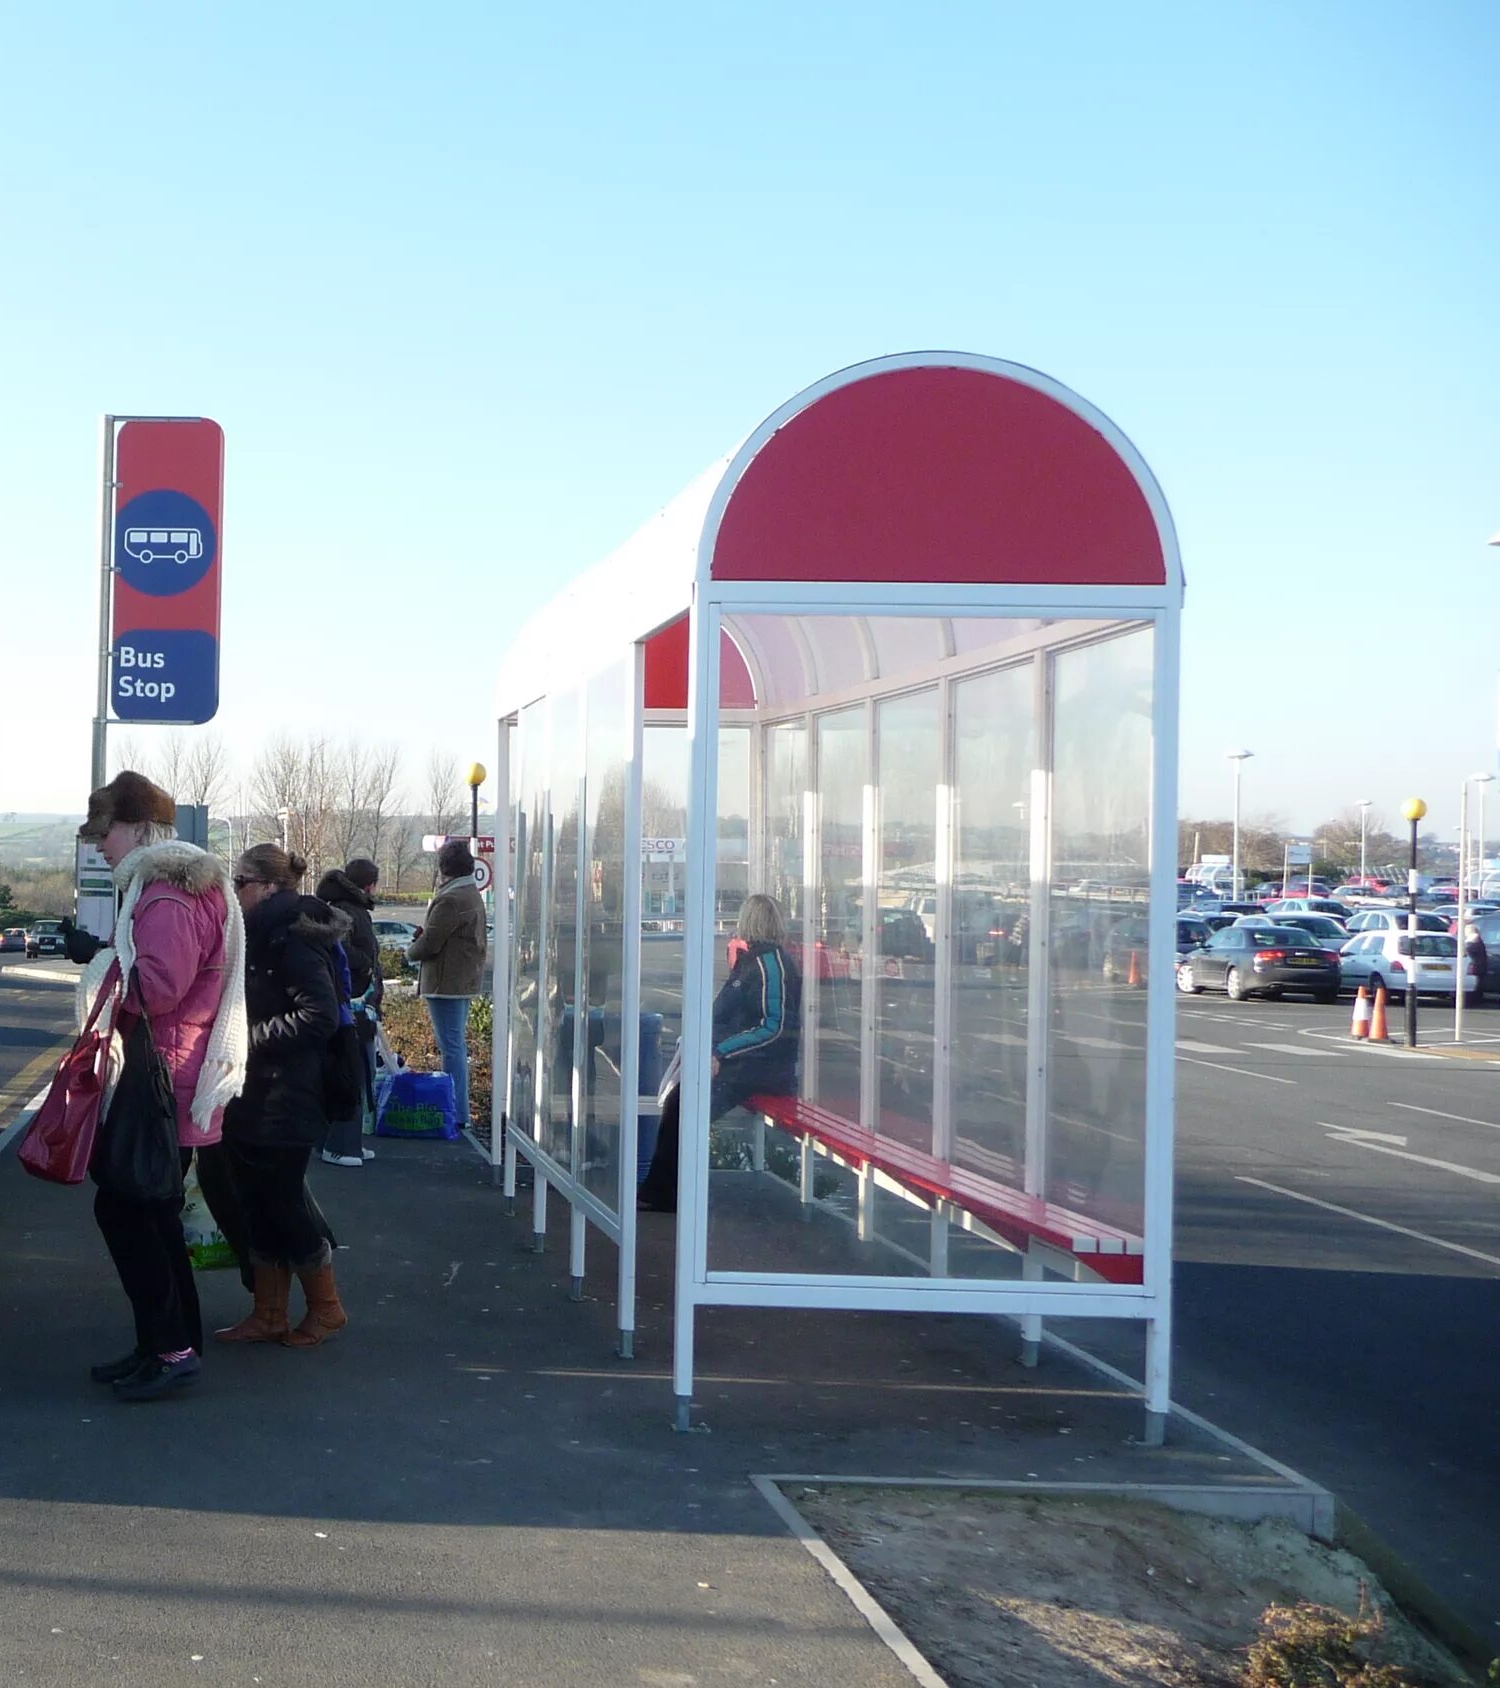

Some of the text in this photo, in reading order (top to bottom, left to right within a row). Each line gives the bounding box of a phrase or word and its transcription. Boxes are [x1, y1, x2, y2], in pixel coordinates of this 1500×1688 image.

[120, 646, 165, 668] Bus
[118, 675, 175, 703] Stop
[642, 840, 676, 850] ESCO
[475, 868, 485, 881] 0
